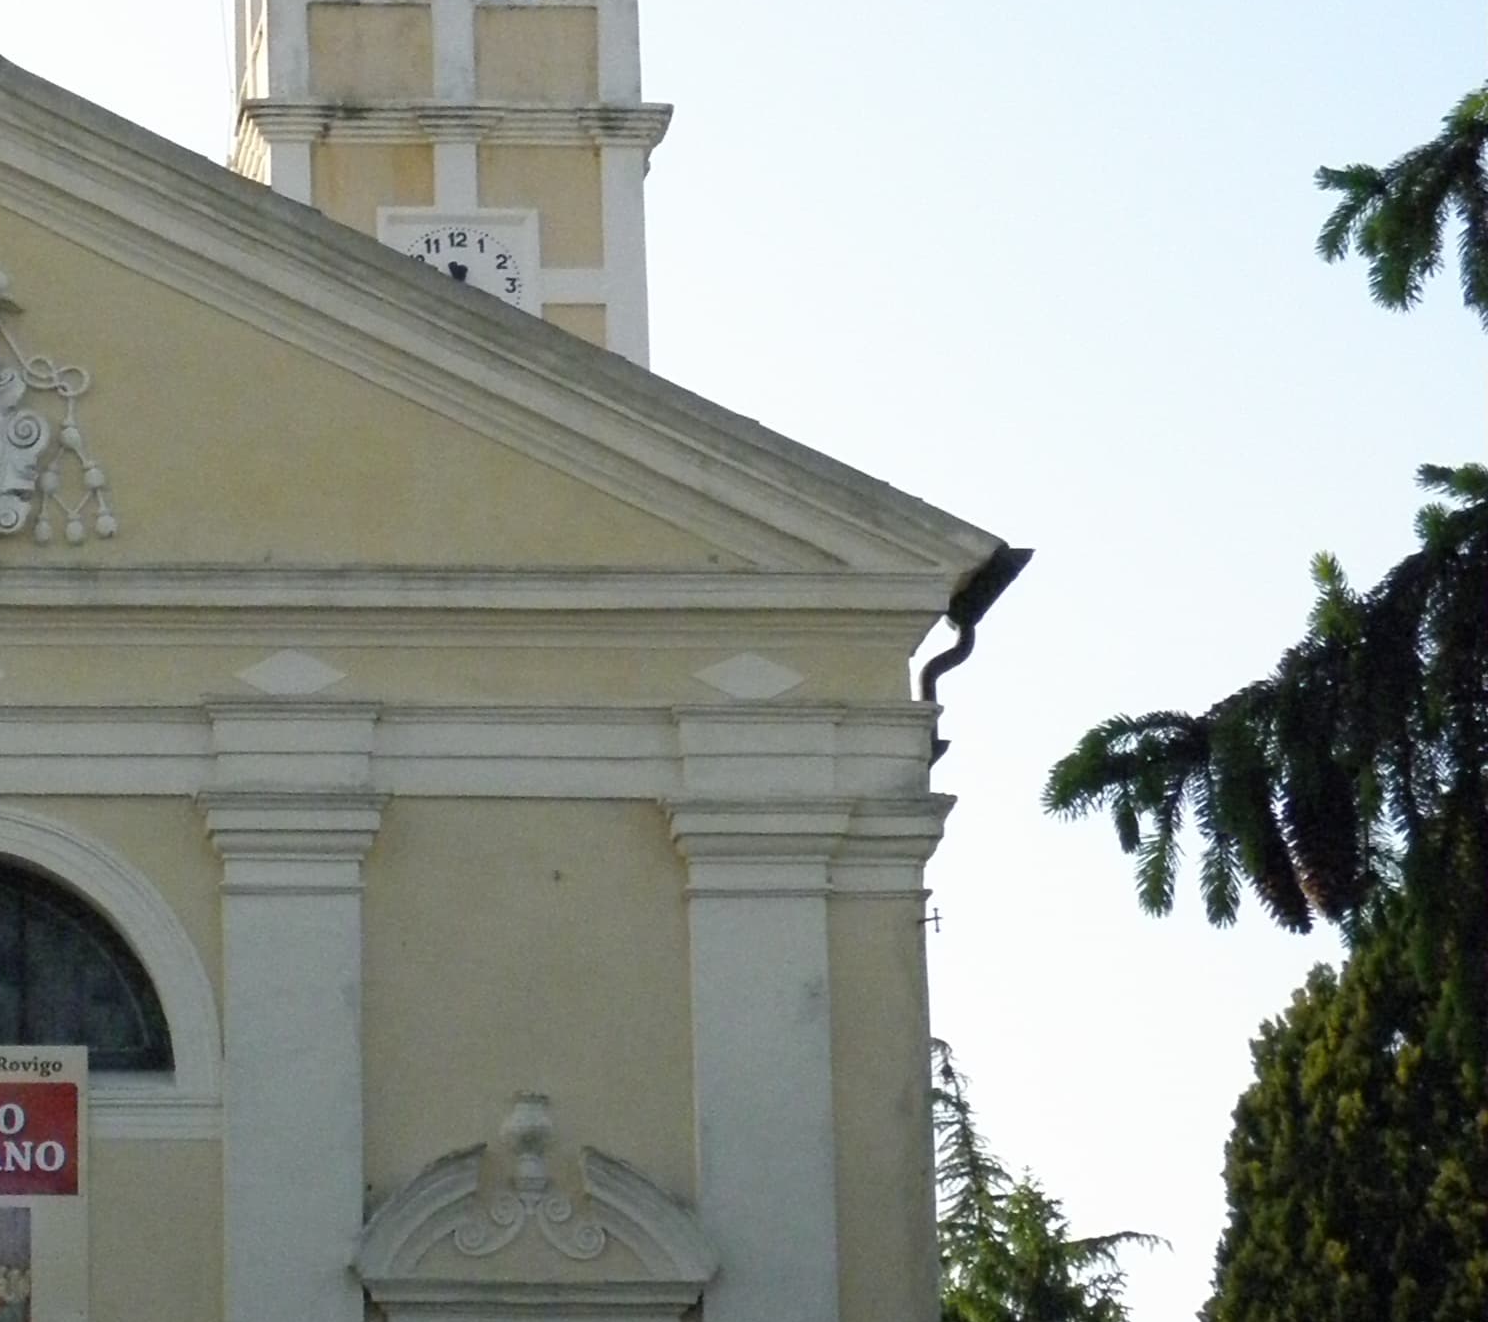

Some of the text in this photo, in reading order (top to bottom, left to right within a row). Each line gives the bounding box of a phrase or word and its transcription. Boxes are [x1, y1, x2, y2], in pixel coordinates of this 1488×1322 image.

[425, 238, 441, 254] 11
[448, 232, 468, 248] 12
[477, 238, 485, 253] 1
[495, 254, 508, 269] 2
[505, 278, 517, 293] 3
